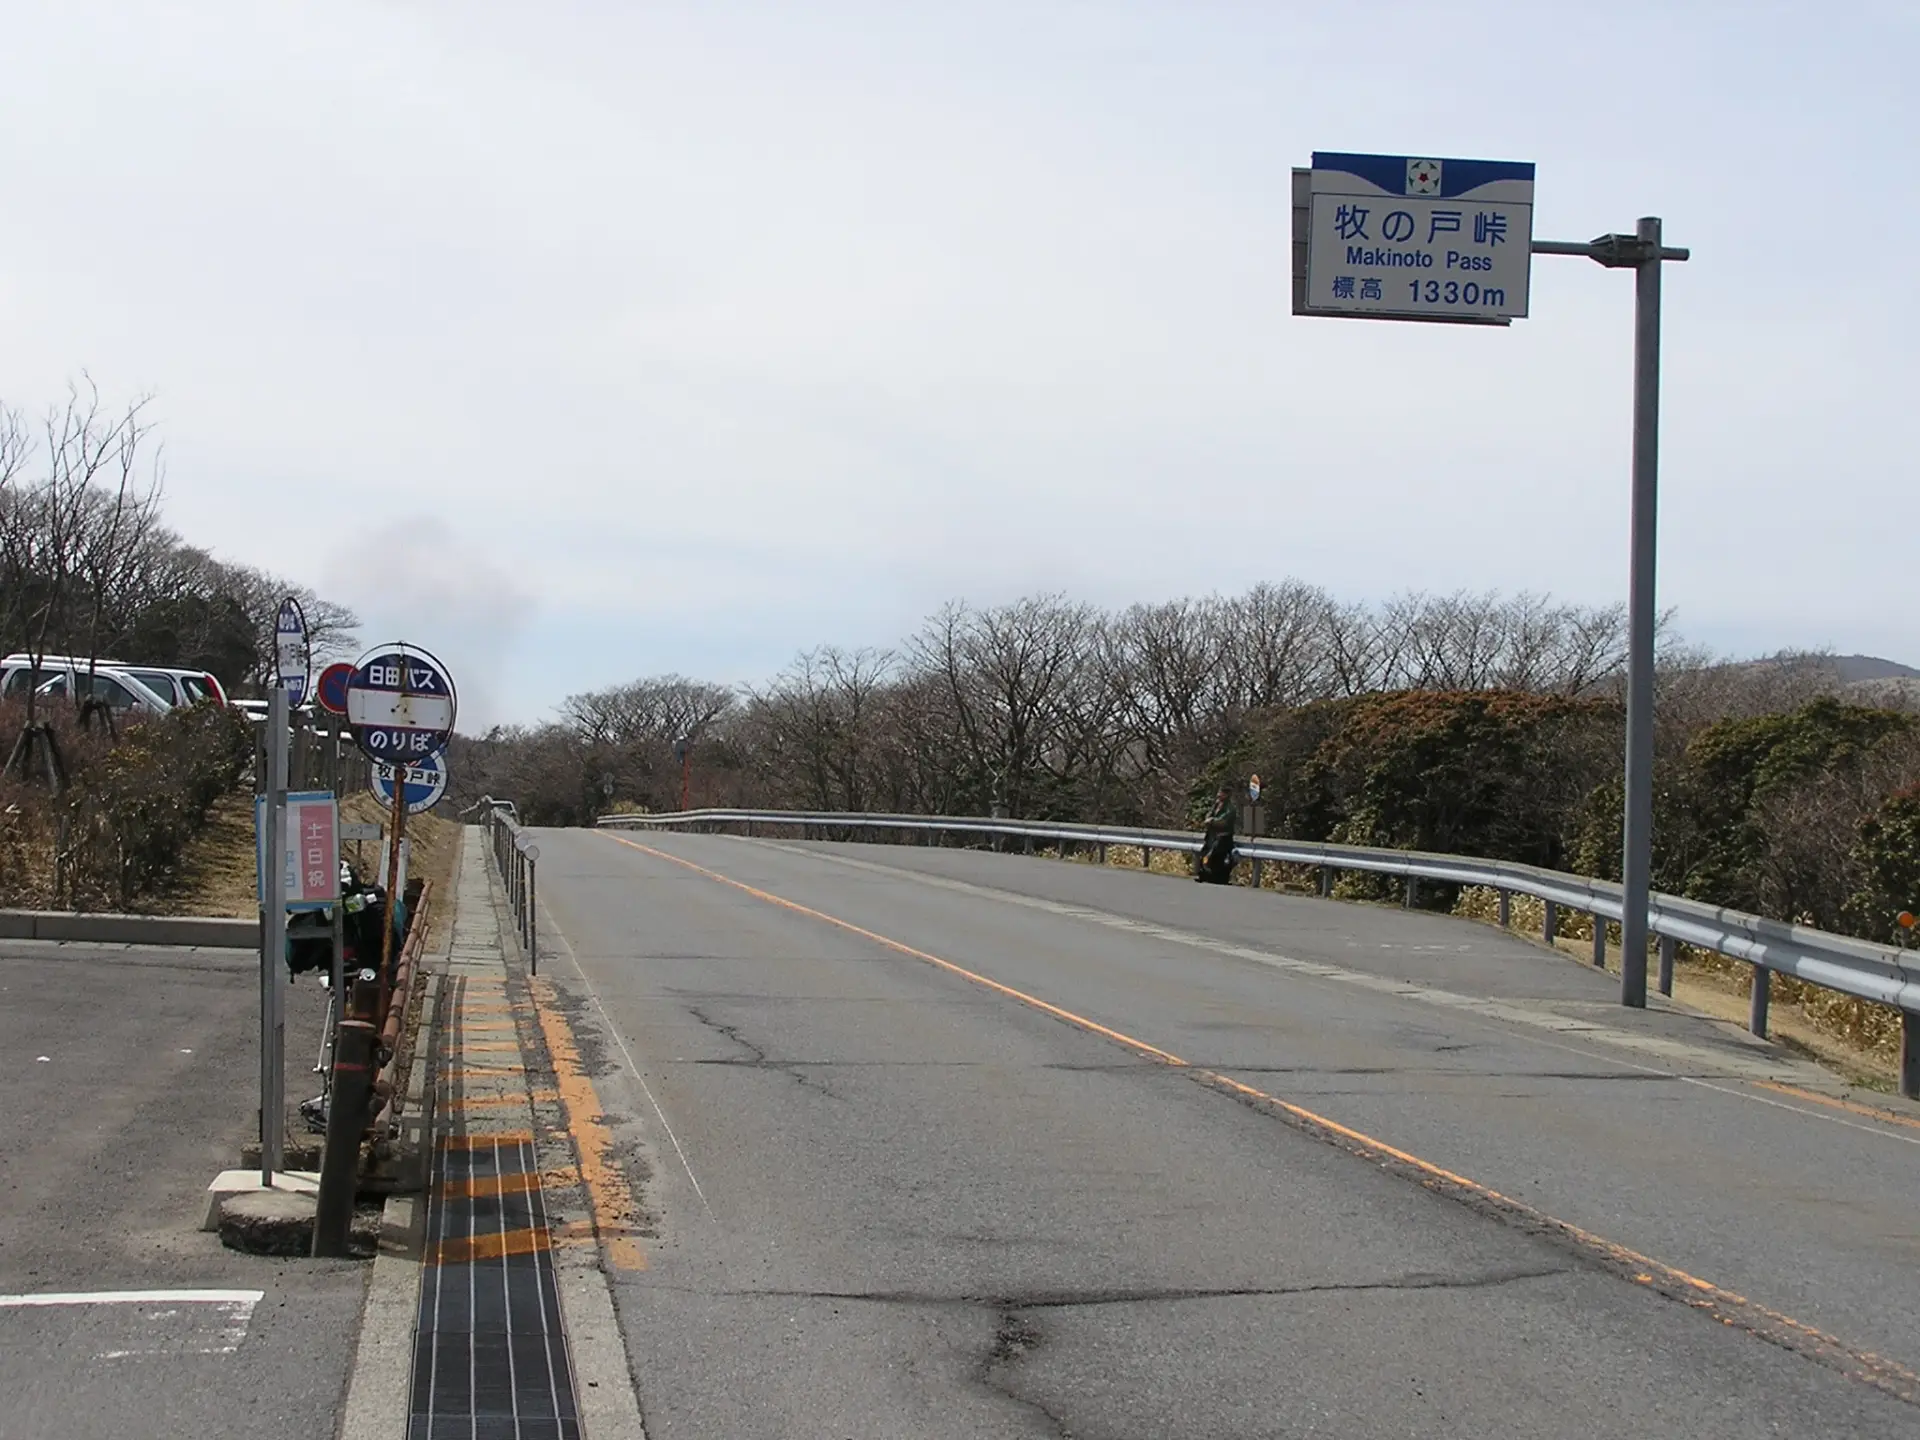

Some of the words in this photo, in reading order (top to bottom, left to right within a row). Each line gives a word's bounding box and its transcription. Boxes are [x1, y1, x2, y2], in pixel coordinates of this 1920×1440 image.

[1334, 204, 1507, 247] 牧の戸峠
[1346, 246, 1433, 269] Makinoto
[1446, 251, 1492, 271] Pass
[1332, 276, 1382, 301] 標高
[1408, 279, 1505, 306] 1330m
[369, 665, 435, 689] 日田バス
[369, 730, 432, 751] のりば
